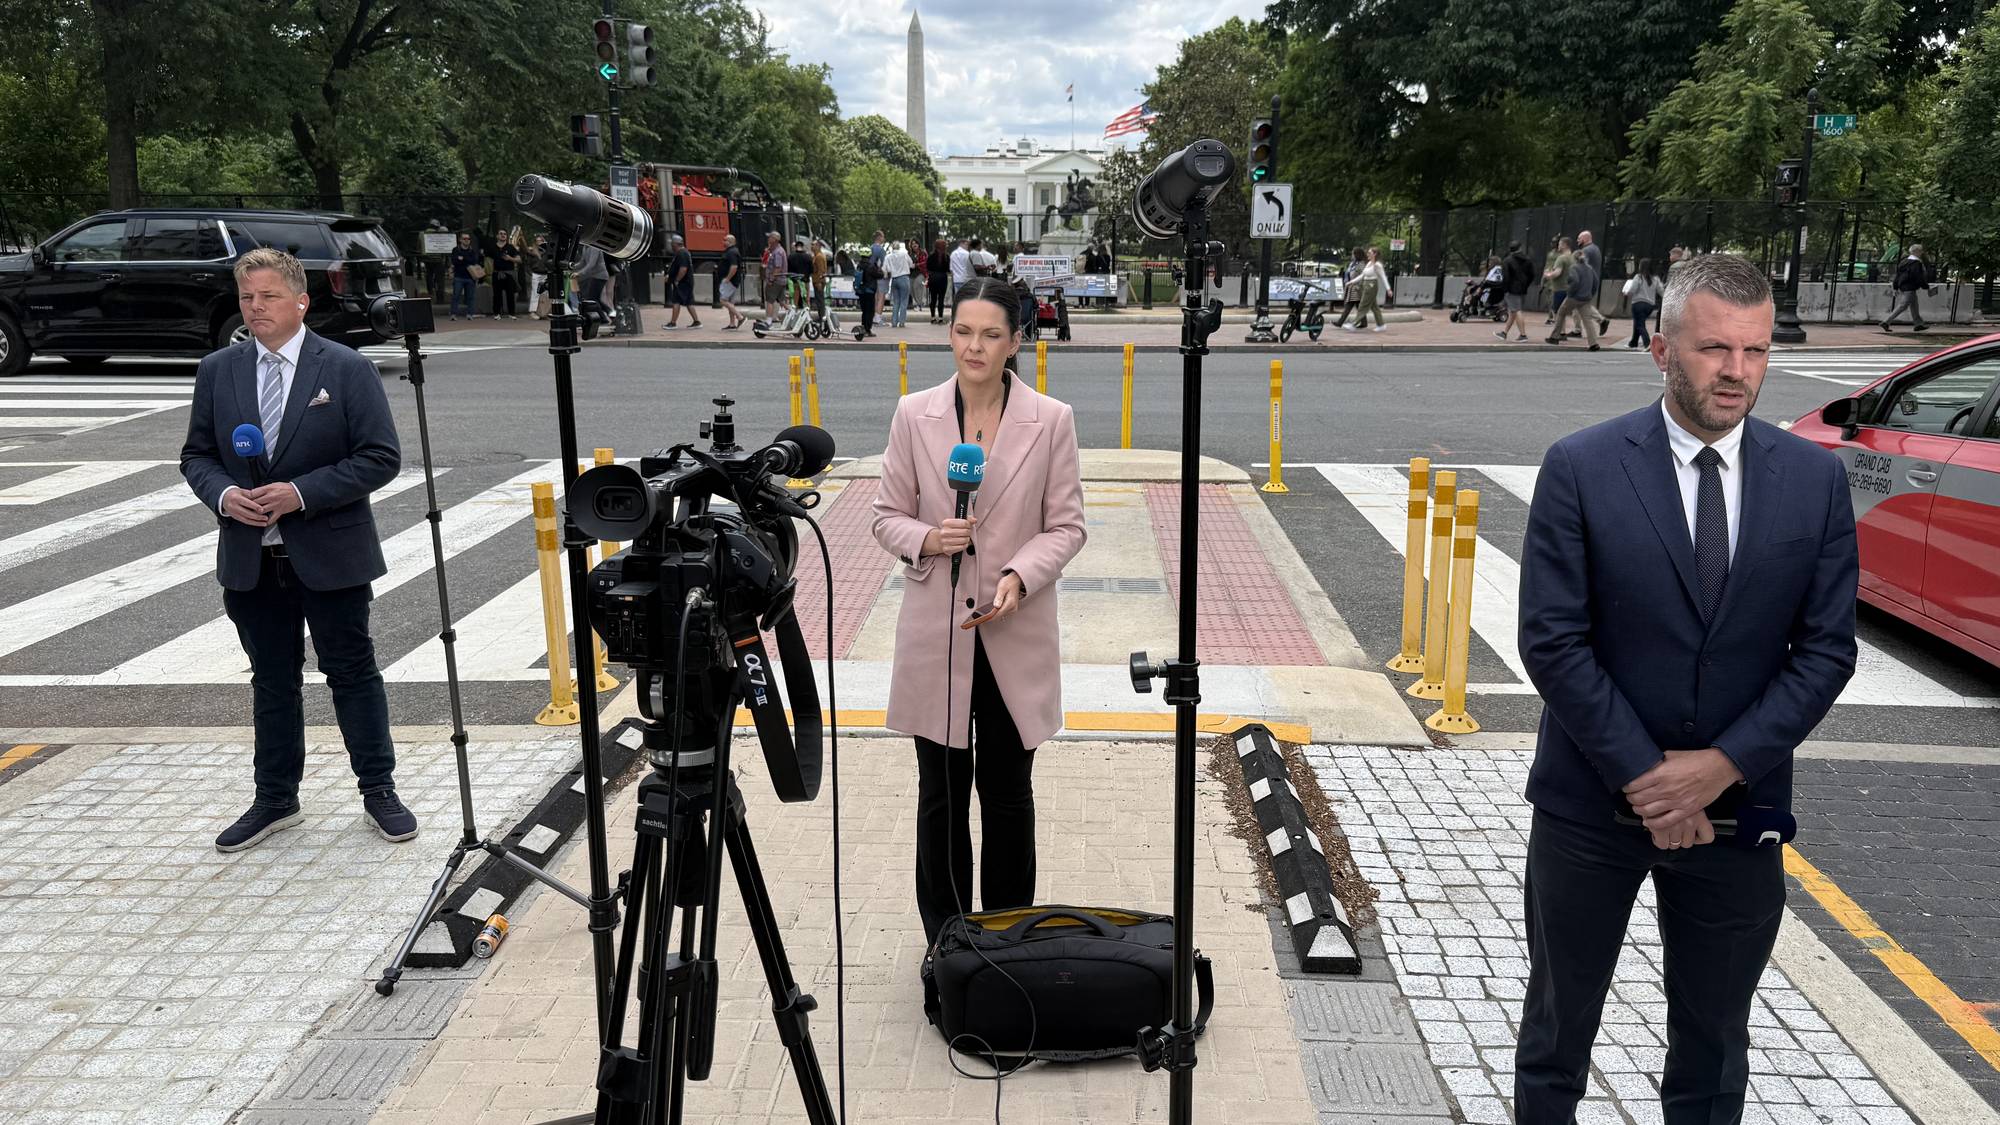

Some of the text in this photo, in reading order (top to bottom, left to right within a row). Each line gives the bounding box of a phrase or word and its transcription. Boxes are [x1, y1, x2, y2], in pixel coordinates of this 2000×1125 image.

[1824, 116, 1833, 127] H
[1823, 127, 1843, 135] 1600
[688, 214, 725, 230] TOTAL
[1257, 223, 1285, 232] ONLY
[1854, 453, 1892, 473] GRAND CAB
